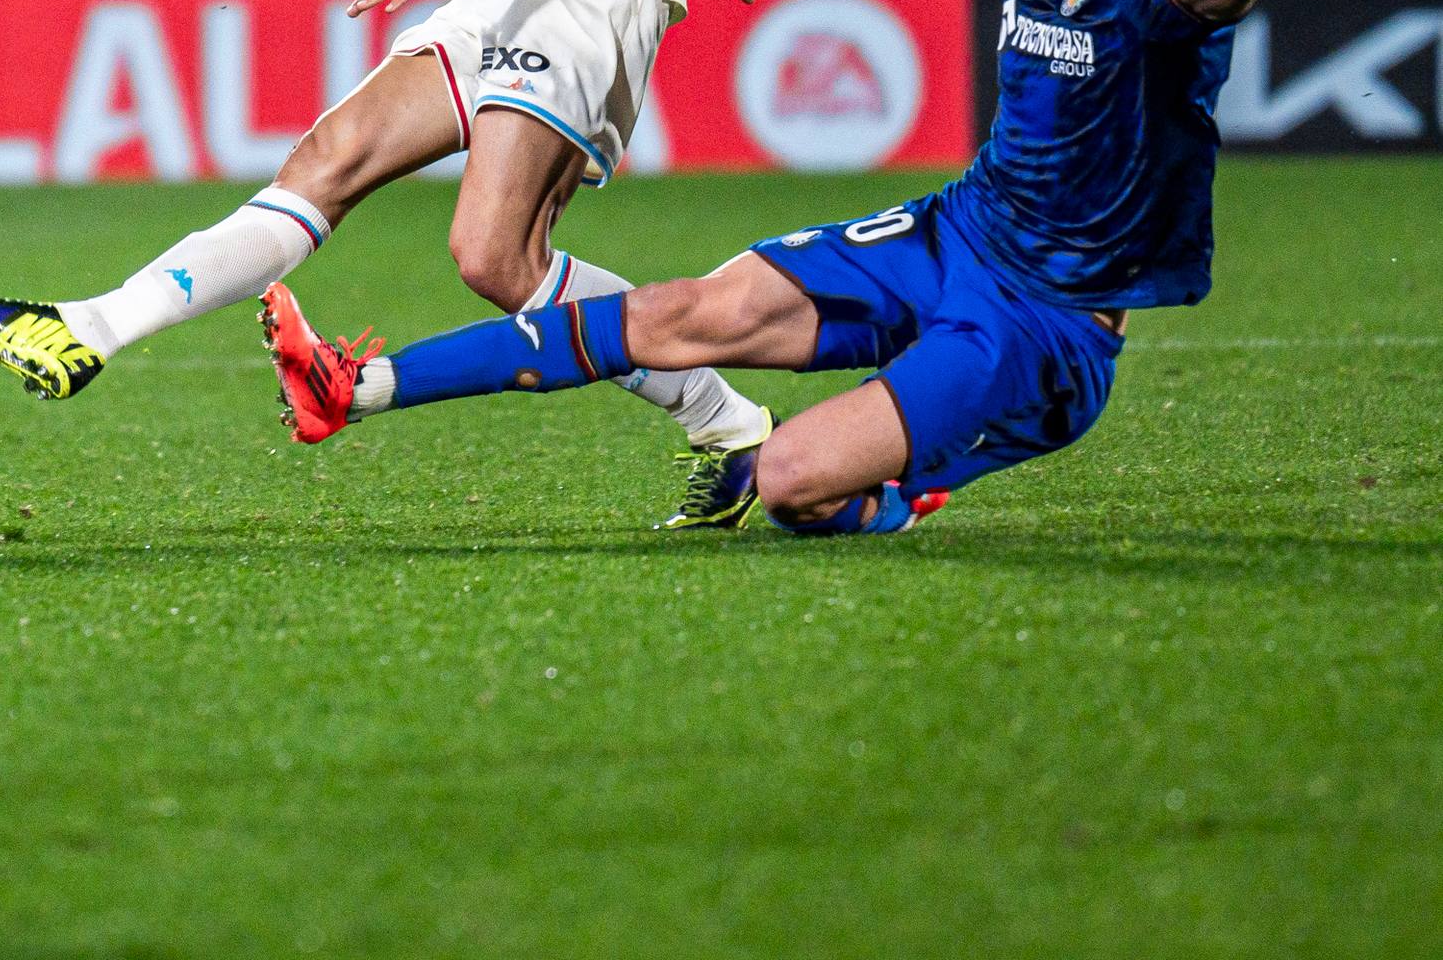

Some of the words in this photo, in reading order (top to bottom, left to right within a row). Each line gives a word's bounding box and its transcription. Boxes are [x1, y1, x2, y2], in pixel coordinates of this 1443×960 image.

[1011, 14, 1096, 64] TECNOCASA
[1050, 59, 1096, 77] GROUP
[845, 206, 916, 243] 0
